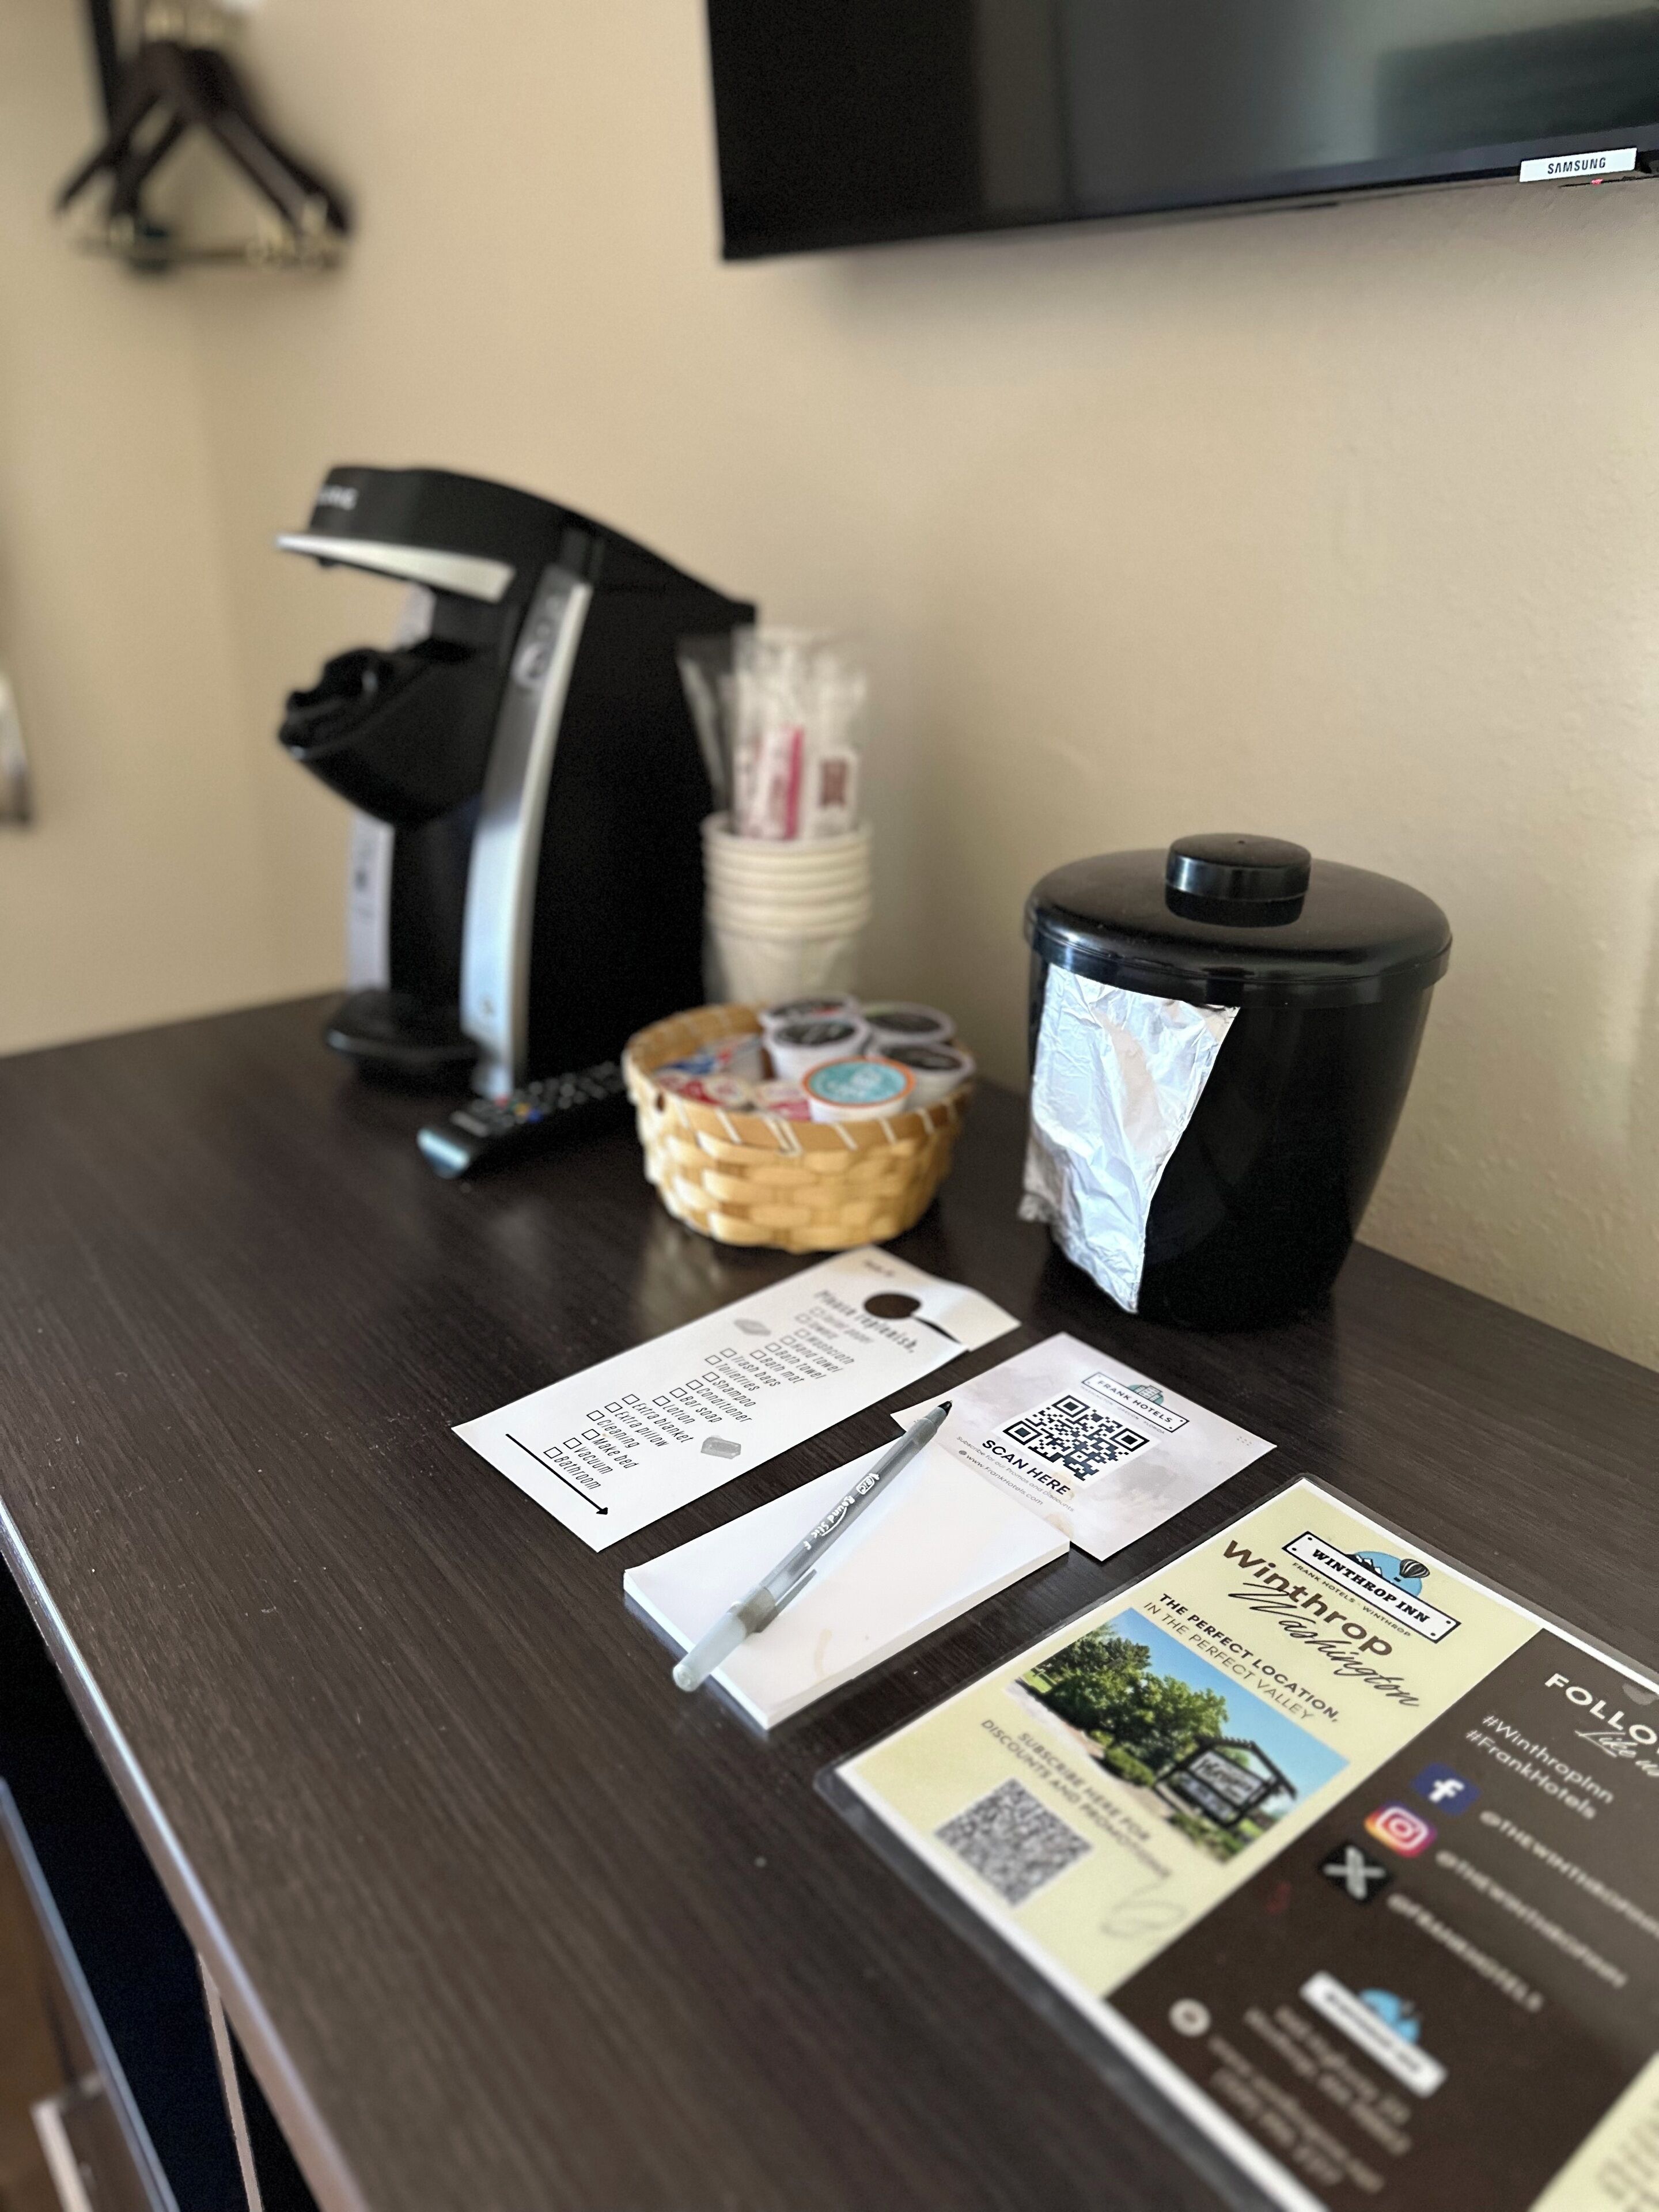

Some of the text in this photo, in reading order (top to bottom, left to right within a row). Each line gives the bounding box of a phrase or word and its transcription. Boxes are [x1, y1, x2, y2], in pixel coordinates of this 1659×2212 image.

[1548, 157, 1606, 174] SAMSUNG
[855, 1313, 917, 1353] replenish,
[731, 1356, 781, 1387] Trash bags
[760, 1357, 805, 1384] Bath mat
[775, 1350, 827, 1380] Bath towel
[789, 1343, 844, 1373] Hand towel
[713, 1380, 756, 1407] Shampoo
[715, 1363, 760, 1391] Toiletries
[663, 1404, 695, 1424] Lotion
[680, 1396, 722, 1422] Bar soap
[696, 1388, 752, 1422] Conditioner
[1097, 1380, 1173, 1423] FRANK HOTELS
[597, 1419, 639, 1448] Cleaning
[615, 1411, 669, 1446] Extra pillow
[632, 1403, 694, 1442] Extra blanket
[1118, 1406, 1139, 1420] OREGON
[1143, 1421, 1165, 1434] FLORIDA
[574, 1447, 613, 1474] Vacuum
[592, 1438, 639, 1468] Make bed
[982, 1440, 1070, 1495] SCAN HERE
[554, 1456, 601, 1490] Bathroom
[957, 1437, 985, 1456] Subscribe
[985, 1455, 995, 1463] for
[1006, 1468, 1028, 1484] Promos
[1029, 1482, 1042, 1492] and
[1042, 1491, 1074, 1512] Discounts
[827, 1495, 855, 1523] Round
[1223, 1540, 1392, 1657] Winthrop
[1292, 1562, 1411, 1637] FRANK HOTELS WINTHROP
[1312, 1549, 1431, 1623] WINTHROP INN
[1144, 1602, 1315, 1720] IN THE PERFECT VALLEY
[1159, 1593, 1339, 1722] THE PERFECT LOCATION,
[1228, 1582, 1419, 1707] Washington
[1544, 1673, 1659, 1753] FOLLO
[981, 1719, 1052, 1779] DISCOUNTS
[1050, 1779, 1081, 1804] AND
[1018, 1732, 1085, 1786] SUBSCRIBE
[1084, 1787, 1121, 1817] HERE
[1465, 1729, 1596, 1820] #FrankHotels
[1482, 1714, 1615, 1804] #WinthropInn
